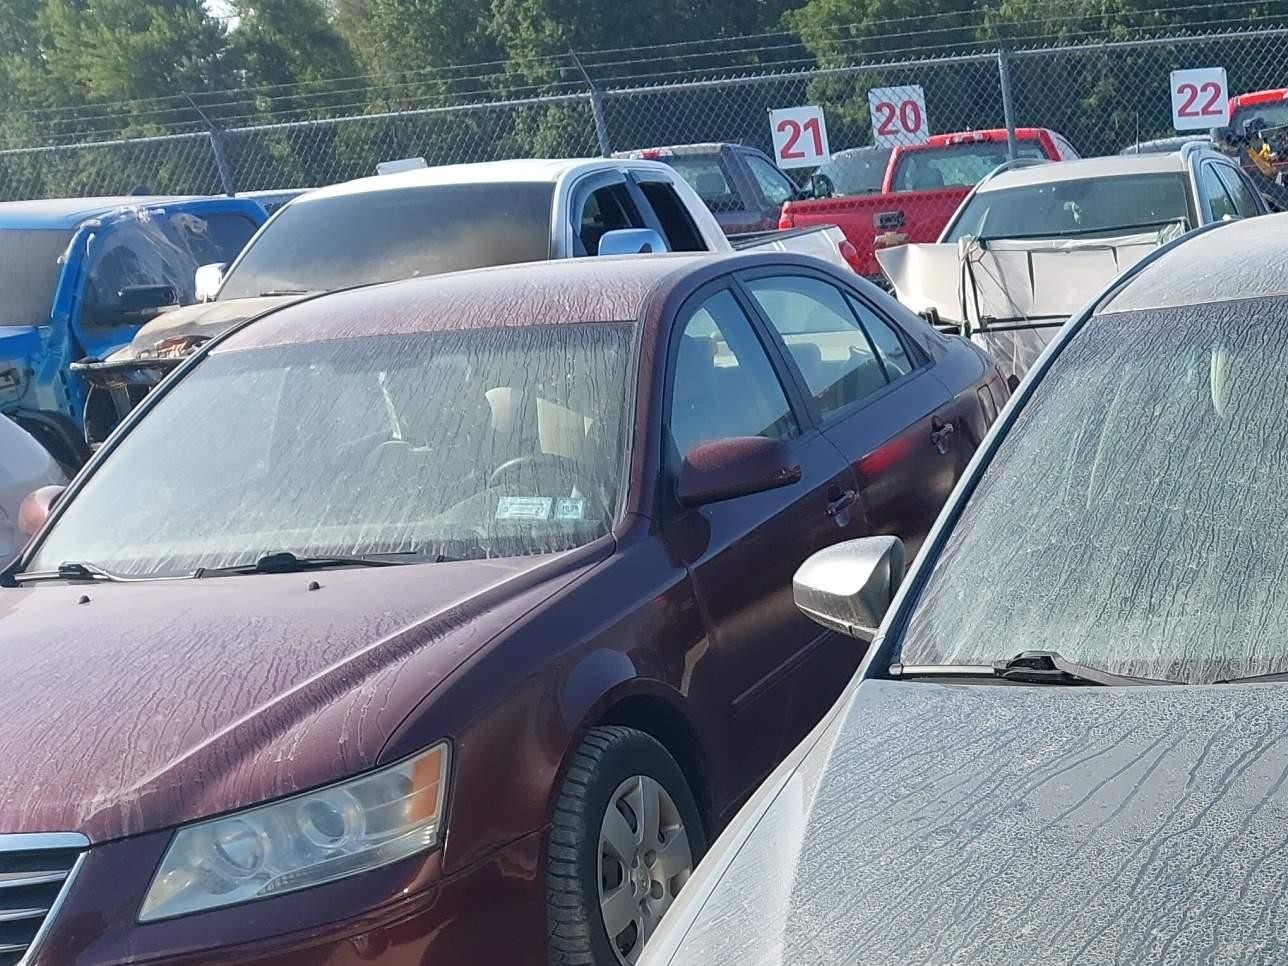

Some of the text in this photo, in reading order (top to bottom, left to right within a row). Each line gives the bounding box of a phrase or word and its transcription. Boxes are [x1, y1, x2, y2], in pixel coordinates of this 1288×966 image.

[874, 99, 922, 136] 20
[1176, 81, 1224, 118] 22
[776, 117, 824, 160] 21
